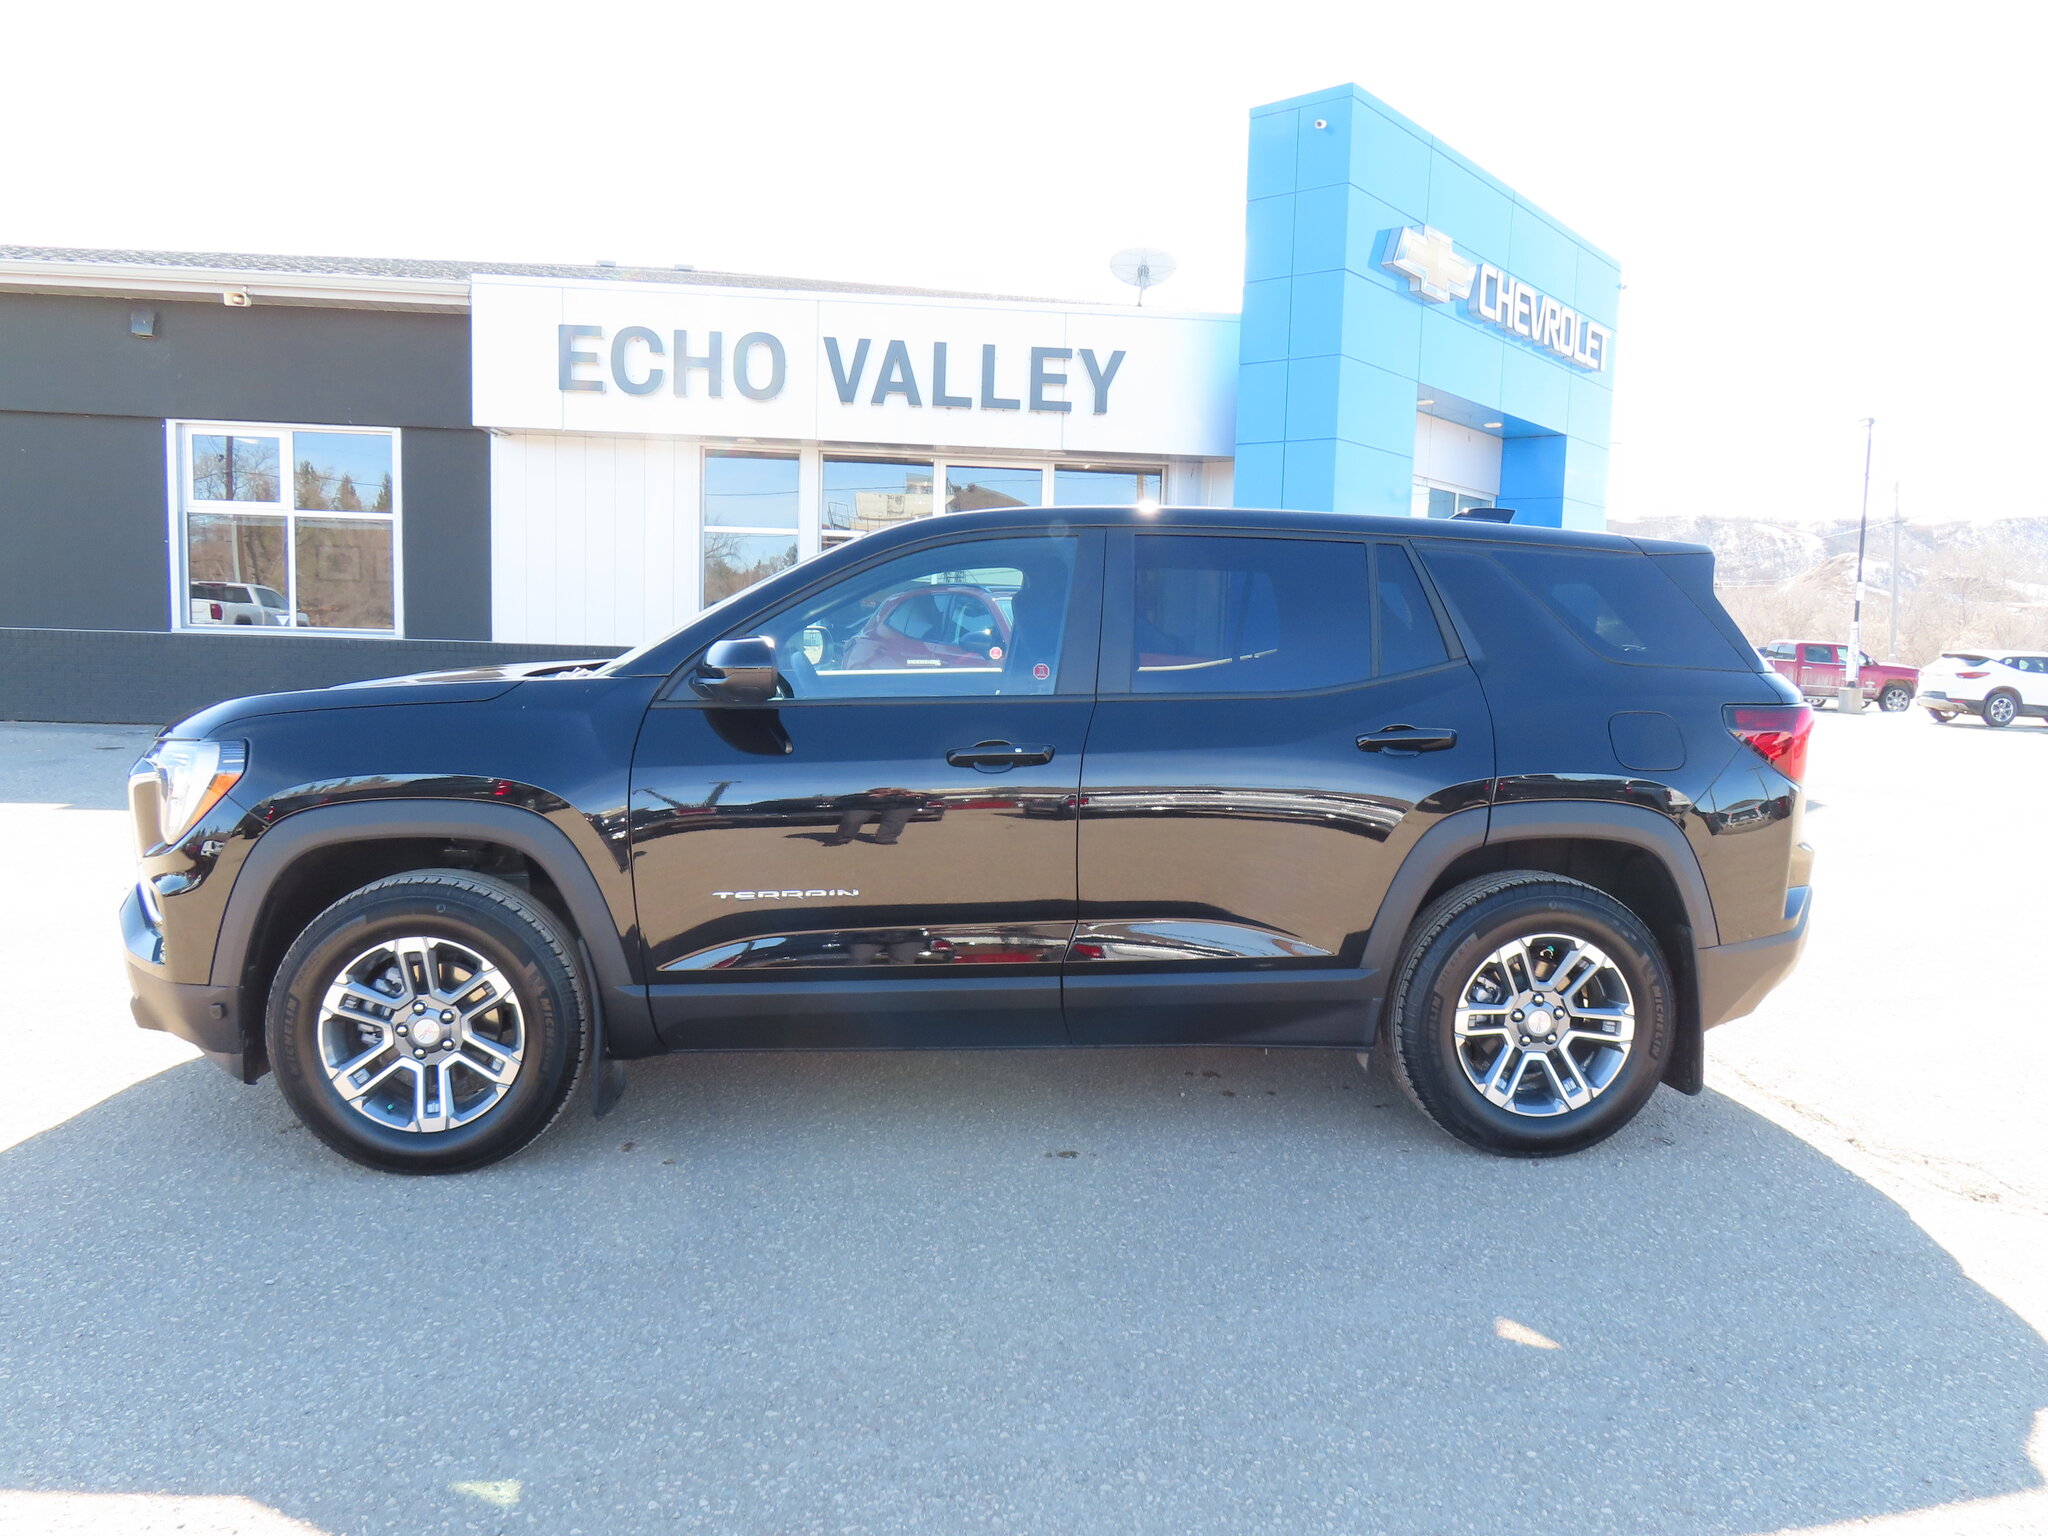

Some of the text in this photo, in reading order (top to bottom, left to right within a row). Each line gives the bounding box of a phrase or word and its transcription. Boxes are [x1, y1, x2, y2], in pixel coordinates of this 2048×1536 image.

[1473, 262, 1611, 372] CHEVROLET
[557, 324, 1127, 416] ECHO VALLEY
[712, 889, 859, 900] TERRAIN
[1652, 985, 1664, 1057] MICHELIN
